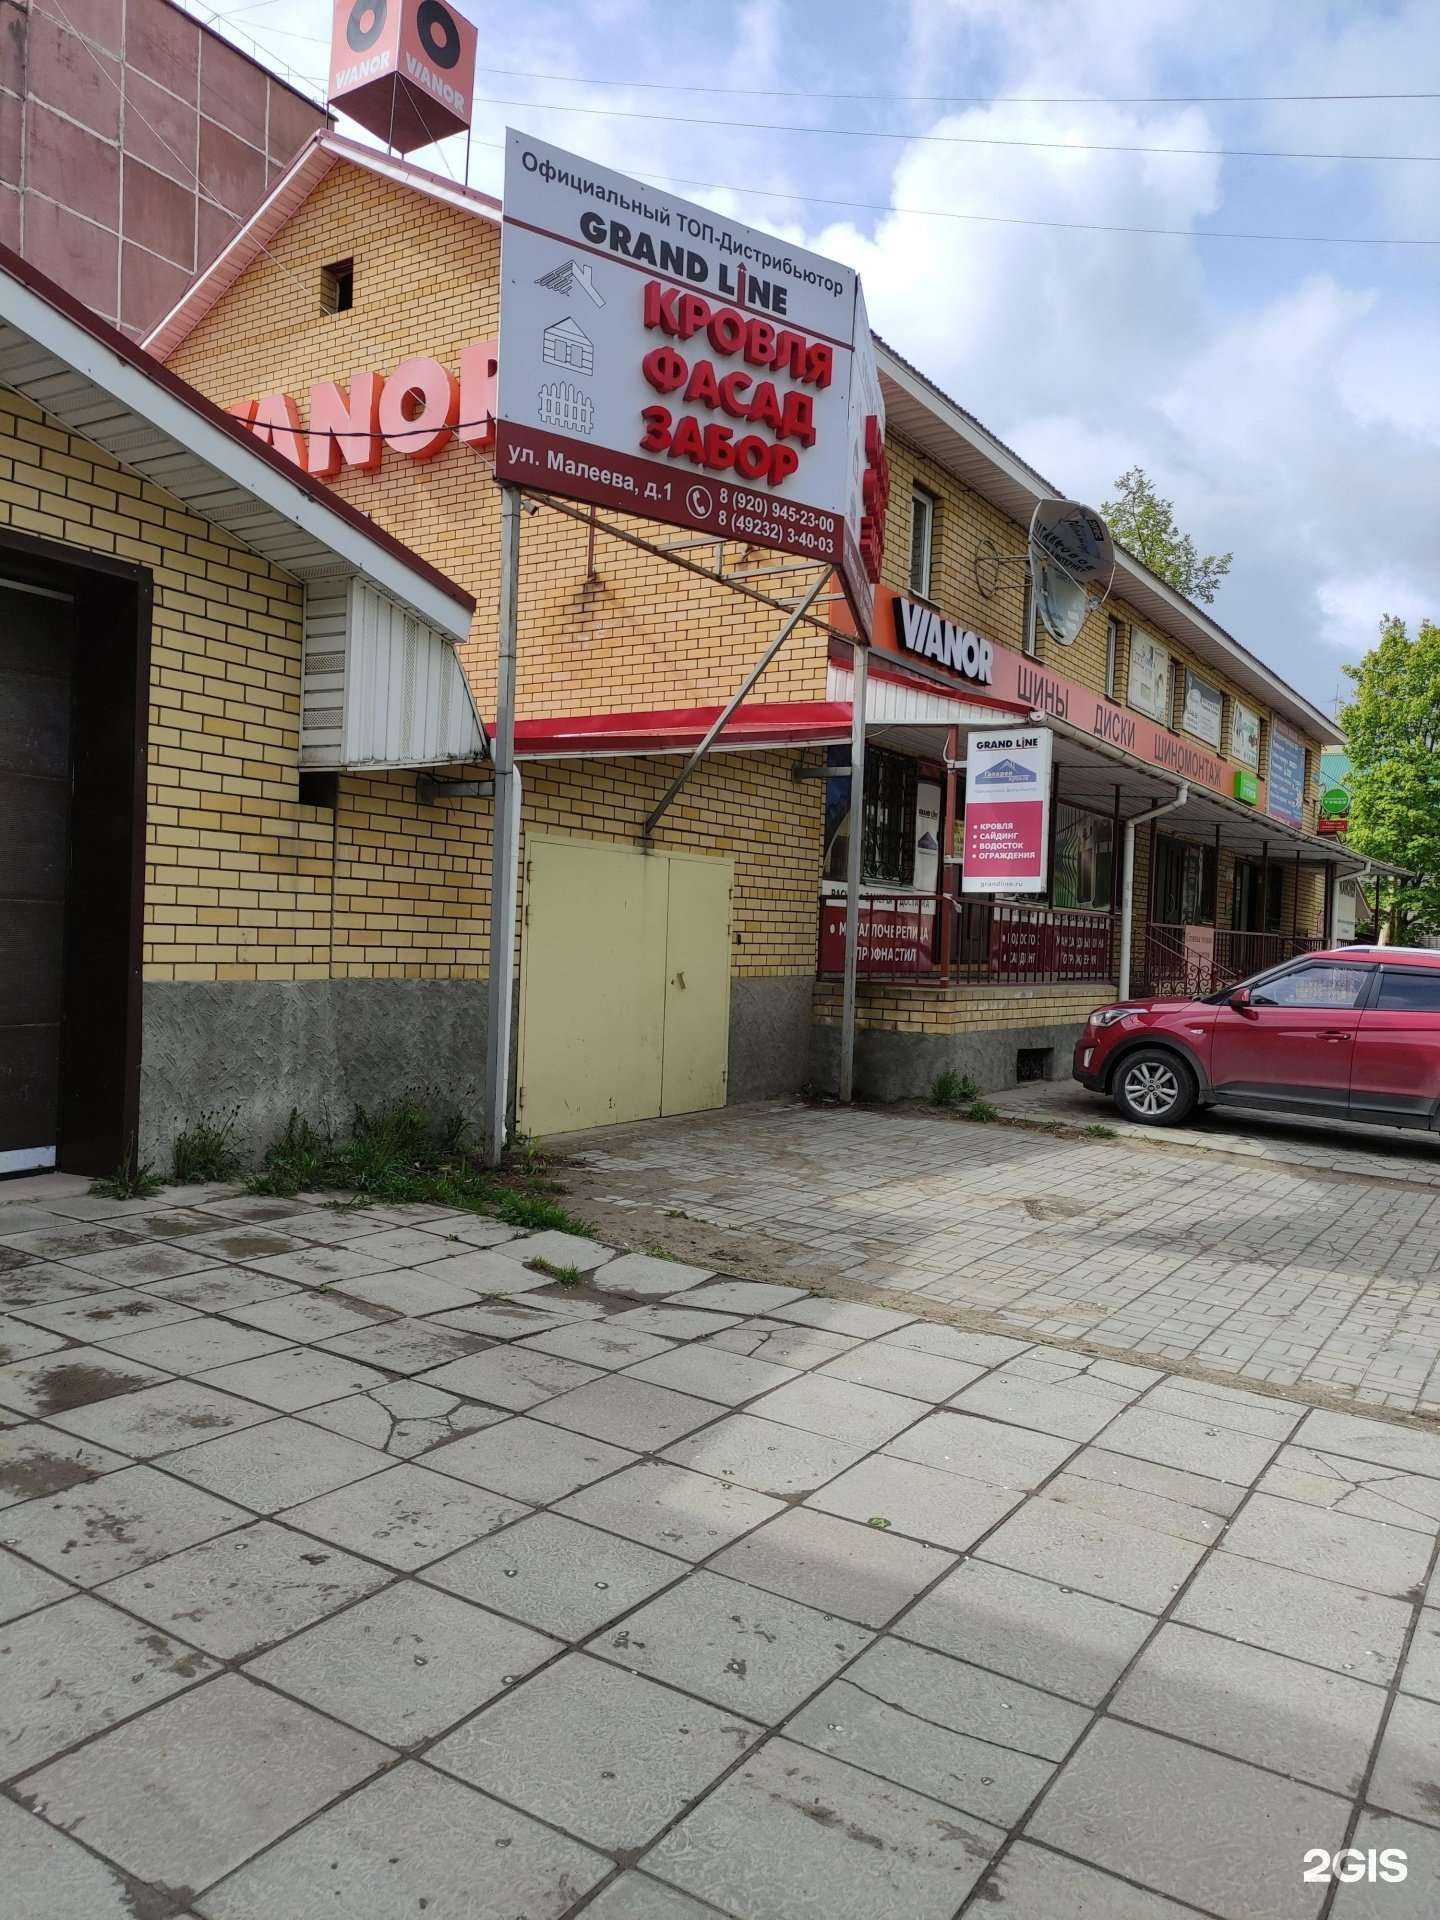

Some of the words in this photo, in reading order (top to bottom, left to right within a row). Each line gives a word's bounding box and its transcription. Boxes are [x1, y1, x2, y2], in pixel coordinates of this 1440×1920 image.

[405, 51, 465, 114] VIANOR
[521, 152, 671, 226] Официальный
[677, 213, 843, 297] ТОП-Дистрибьютор
[580, 211, 709, 283] GRAND
[643, 280, 833, 388] КРОВЛЯ
[642, 345, 816, 447] ФАСАД
[508, 443, 539, 466] ул.
[547, 450, 639, 496] Малеева,
[644, 482, 673, 502] д.1
[639, 405, 799, 486] ЗАБОР
[718, 511, 728, 525] 8
[731, 513, 783, 543] (49232)
[719, 487, 728, 504] 8
[732, 490, 768, 517] (920)
[897, 597, 993, 685] VIANOR
[976, 739, 1013, 750] GRAND
[1017, 665, 1069, 720] ШИНЫ
[1093, 703, 1136, 750] ДИСКИ
[1154, 733, 1223, 786] ШИНОМОНТАЖ
[978, 851, 1036, 861] ОГРАЖДЕНИЯ
[979, 822, 1014, 831] КРОВЛЯ
[979, 831, 1019, 841] САЙДИНГ
[979, 842, 1024, 851] ВОДОСТОК
